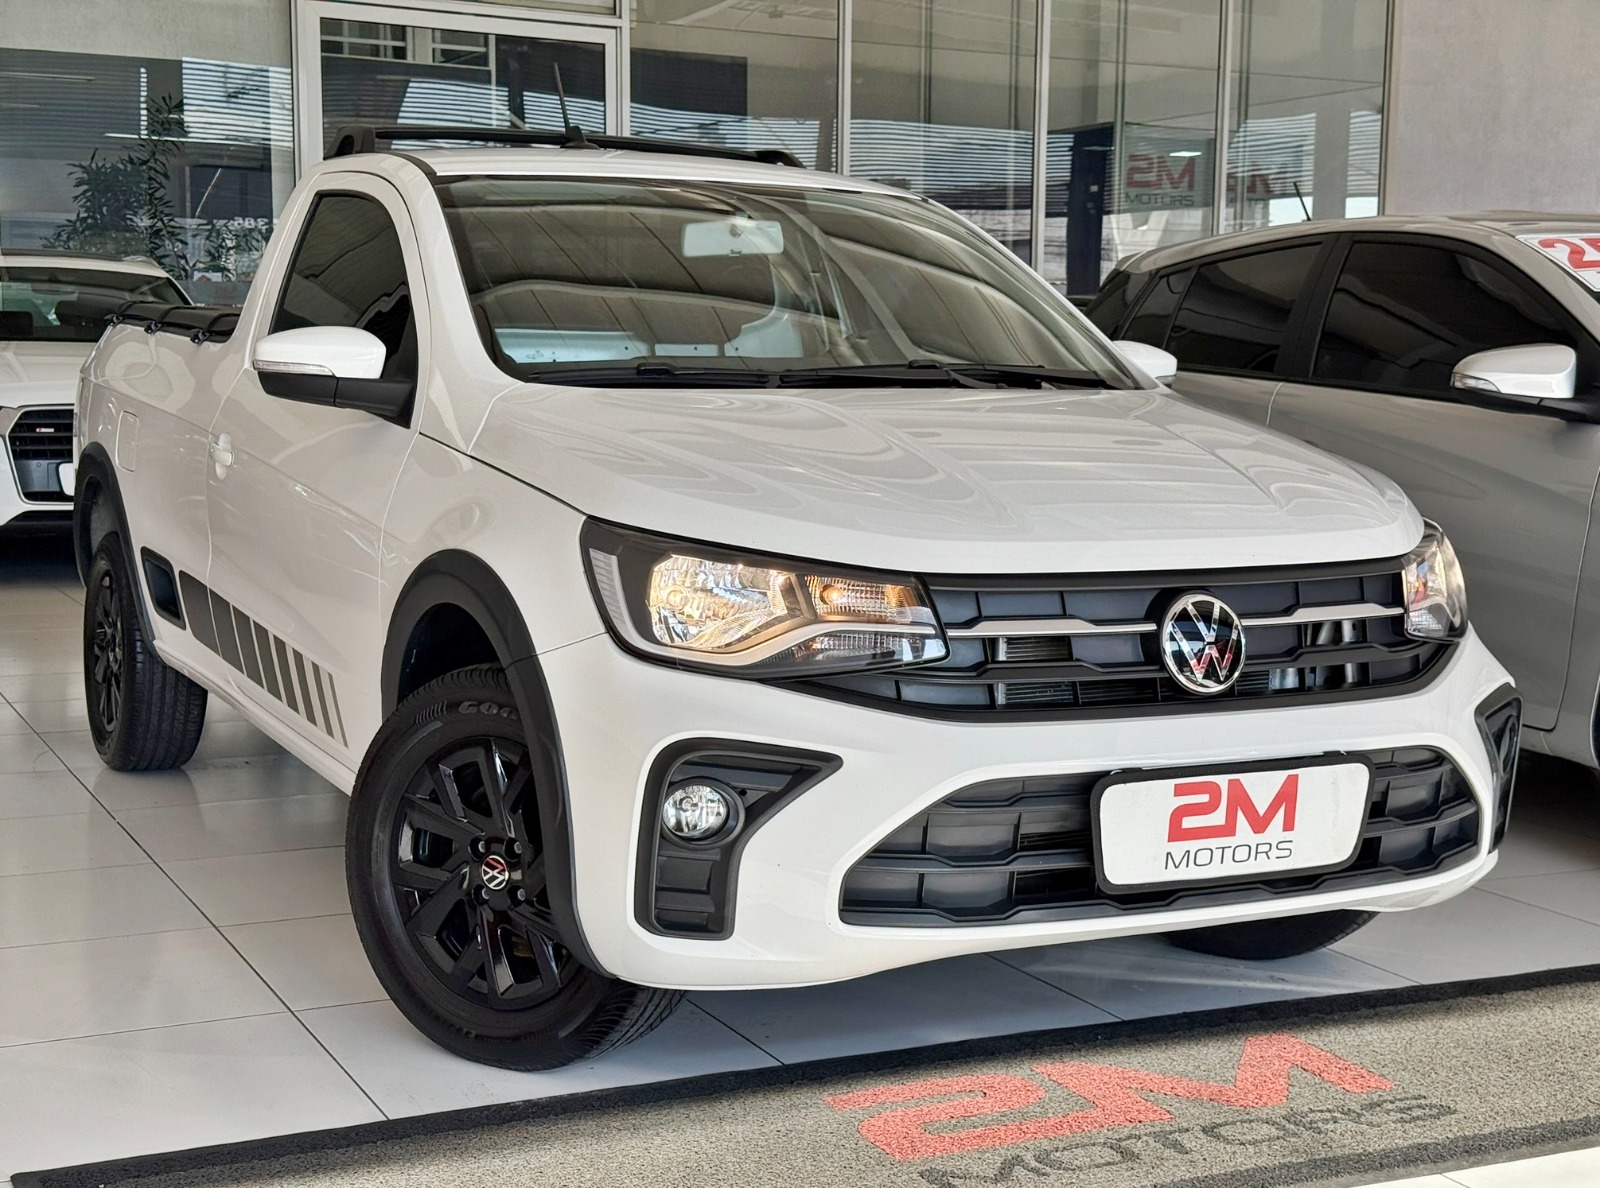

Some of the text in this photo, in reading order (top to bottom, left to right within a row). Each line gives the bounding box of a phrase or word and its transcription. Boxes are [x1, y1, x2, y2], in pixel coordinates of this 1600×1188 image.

[1126, 154, 1196, 192] 2M
[1167, 774, 1299, 843] 2M
[1164, 840, 1293, 870] MOTORS
[822, 1031, 1394, 1161] 2M
